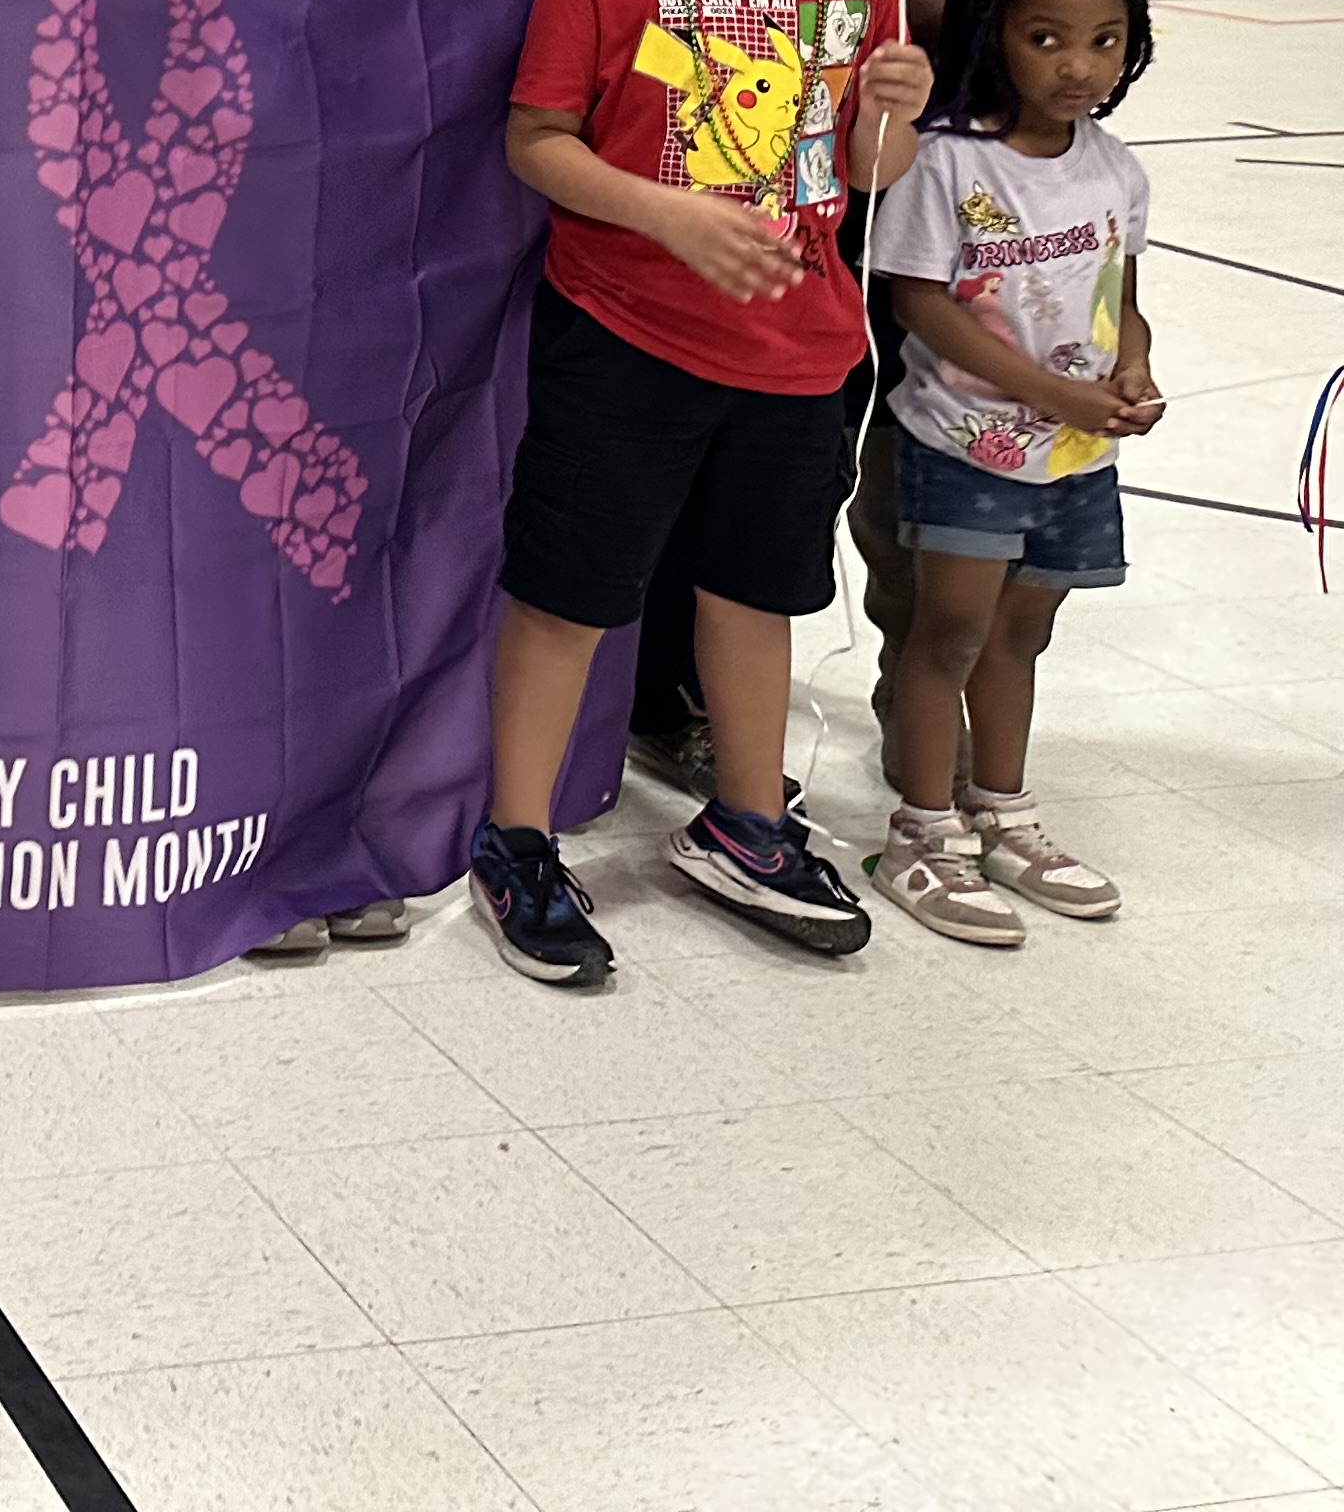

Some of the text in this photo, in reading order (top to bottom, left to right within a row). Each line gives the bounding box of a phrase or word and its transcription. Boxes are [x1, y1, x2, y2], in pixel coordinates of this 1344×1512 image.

[962, 221, 1100, 269] PRINCESS
[48, 748, 199, 829] CHILD
[102, 813, 268, 907] MONTH
